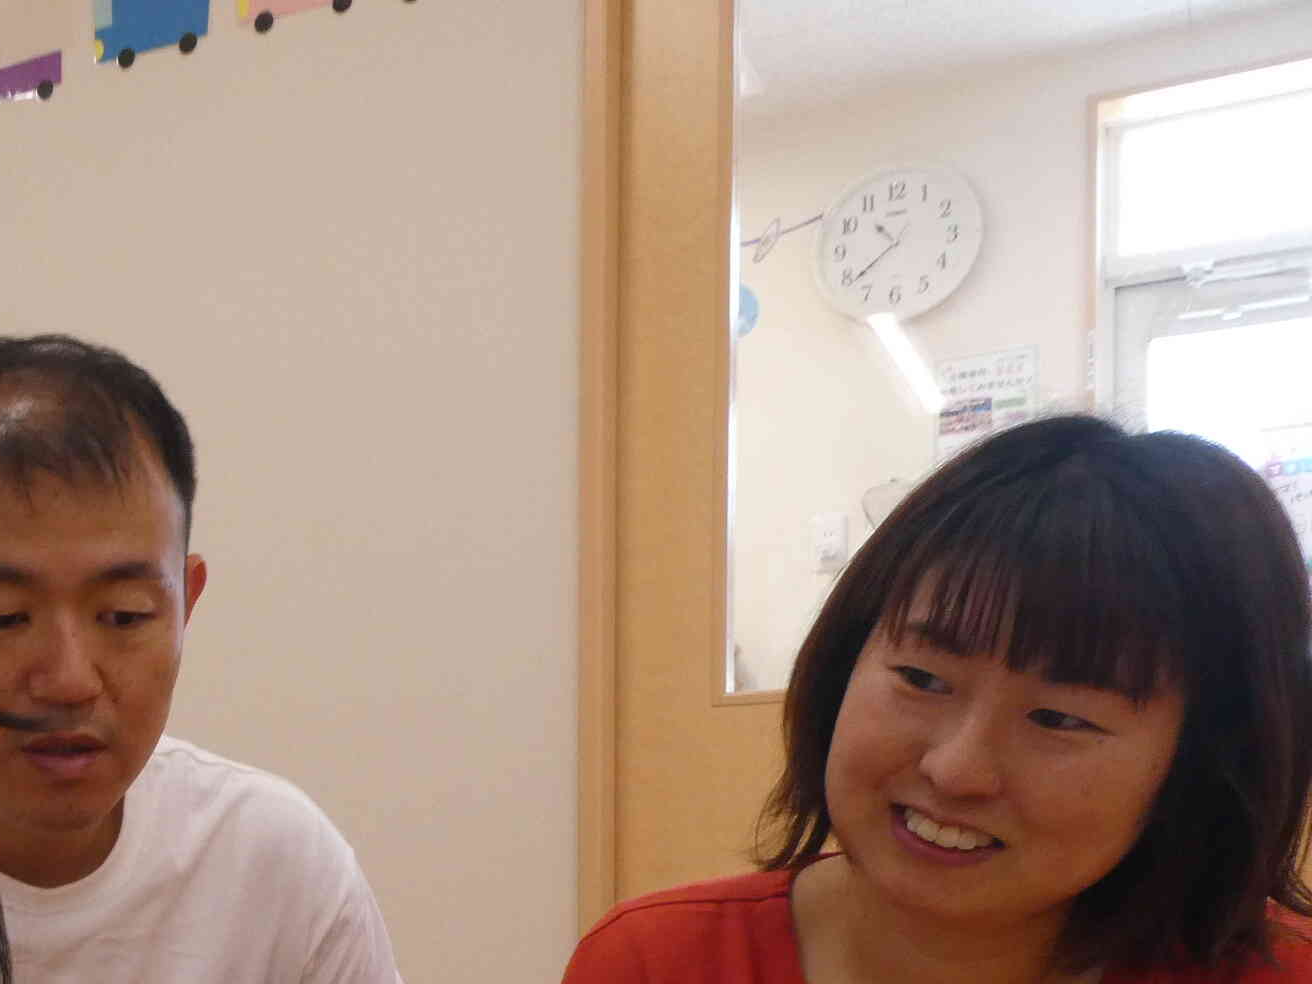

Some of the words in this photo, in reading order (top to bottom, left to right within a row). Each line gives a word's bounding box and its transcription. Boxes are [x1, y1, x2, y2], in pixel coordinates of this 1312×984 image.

[888, 181, 908, 201] 12
[921, 183, 928, 202] 1
[862, 193, 875, 213] 11
[938, 199, 952, 217] 2
[841, 216, 858, 235] 10
[946, 224, 960, 244] 3
[833, 244, 847, 262] 9
[937, 250, 947, 270] 4
[841, 267, 855, 287] 8
[918, 274, 929, 294] 5
[861, 284, 872, 302] 7
[889, 285, 901, 304] 6
